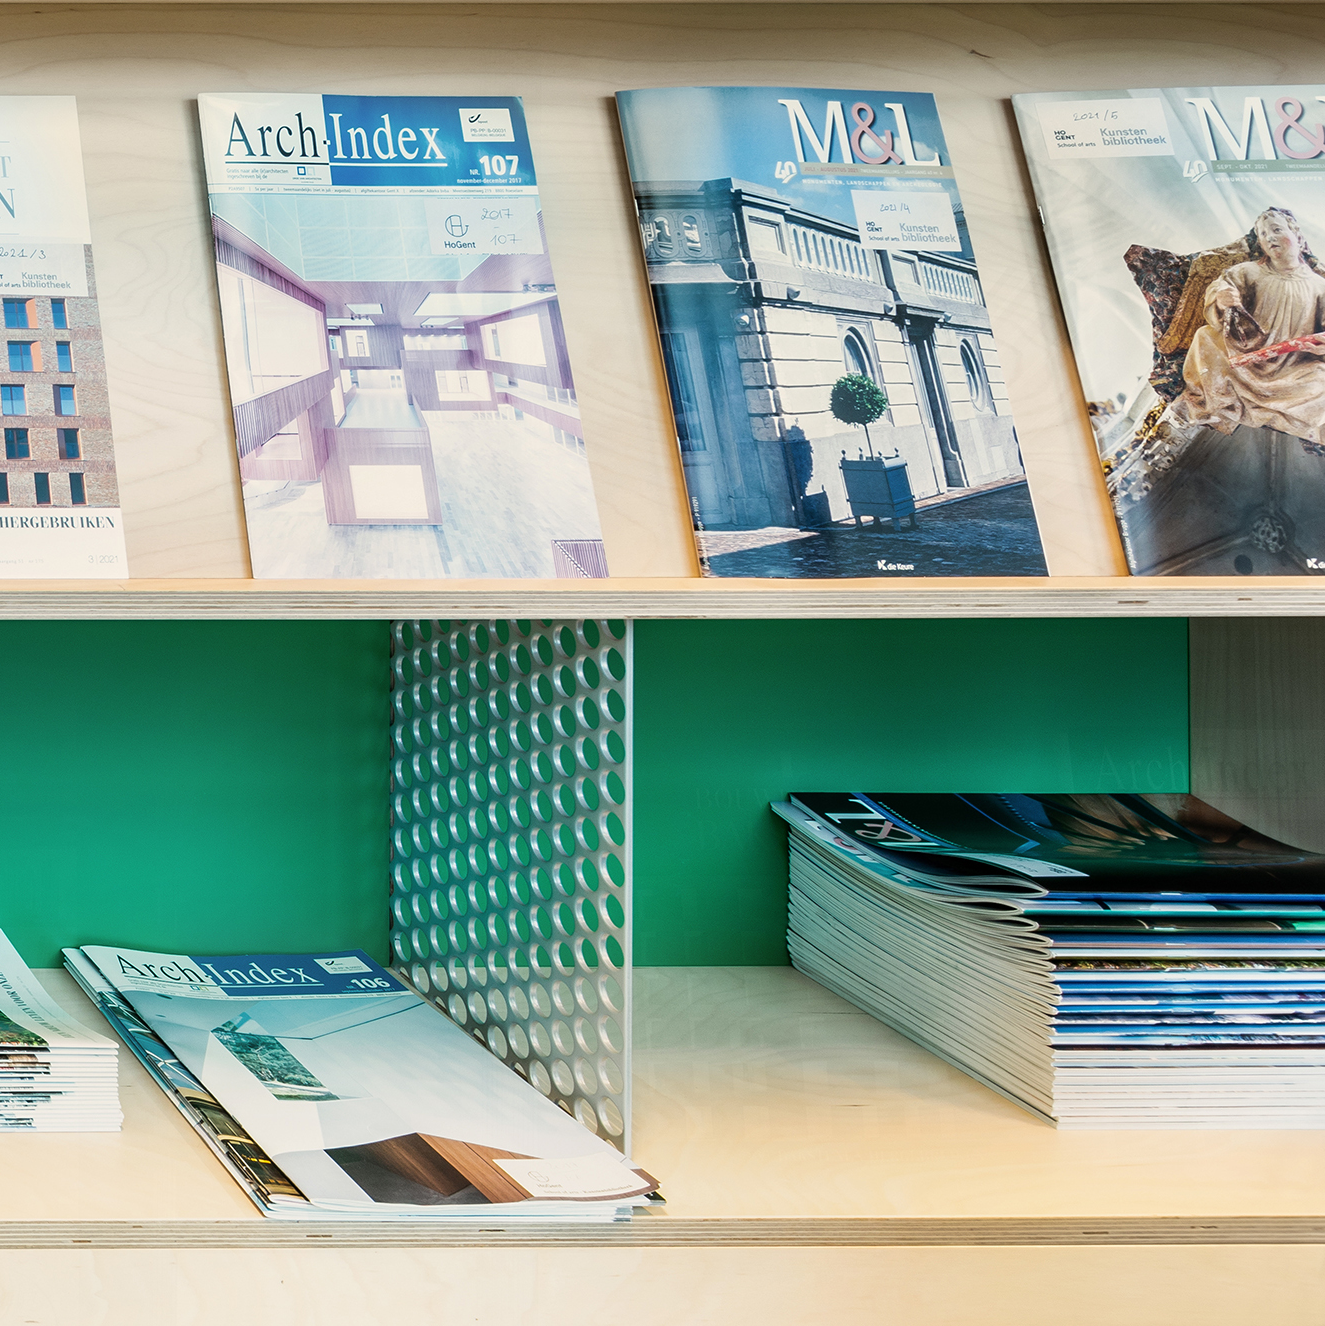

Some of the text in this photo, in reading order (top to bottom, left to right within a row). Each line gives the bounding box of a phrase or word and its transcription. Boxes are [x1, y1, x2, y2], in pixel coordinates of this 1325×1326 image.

[778, 99, 942, 166] M&L
[1100, 128, 1147, 136] Kunsten
[1102, 136, 1166, 146] bibliotheek
[479, 155, 519, 175] 107
[899, 223, 940, 233] Kunsten
[902, 233, 956, 242] bibliotheek
[22, 272, 57, 280] Kunsten
[22, 280, 71, 288] bibliotheek
[0, 516, 115, 528] HERGEBRUIKEN
[351, 978, 390, 989] 106
